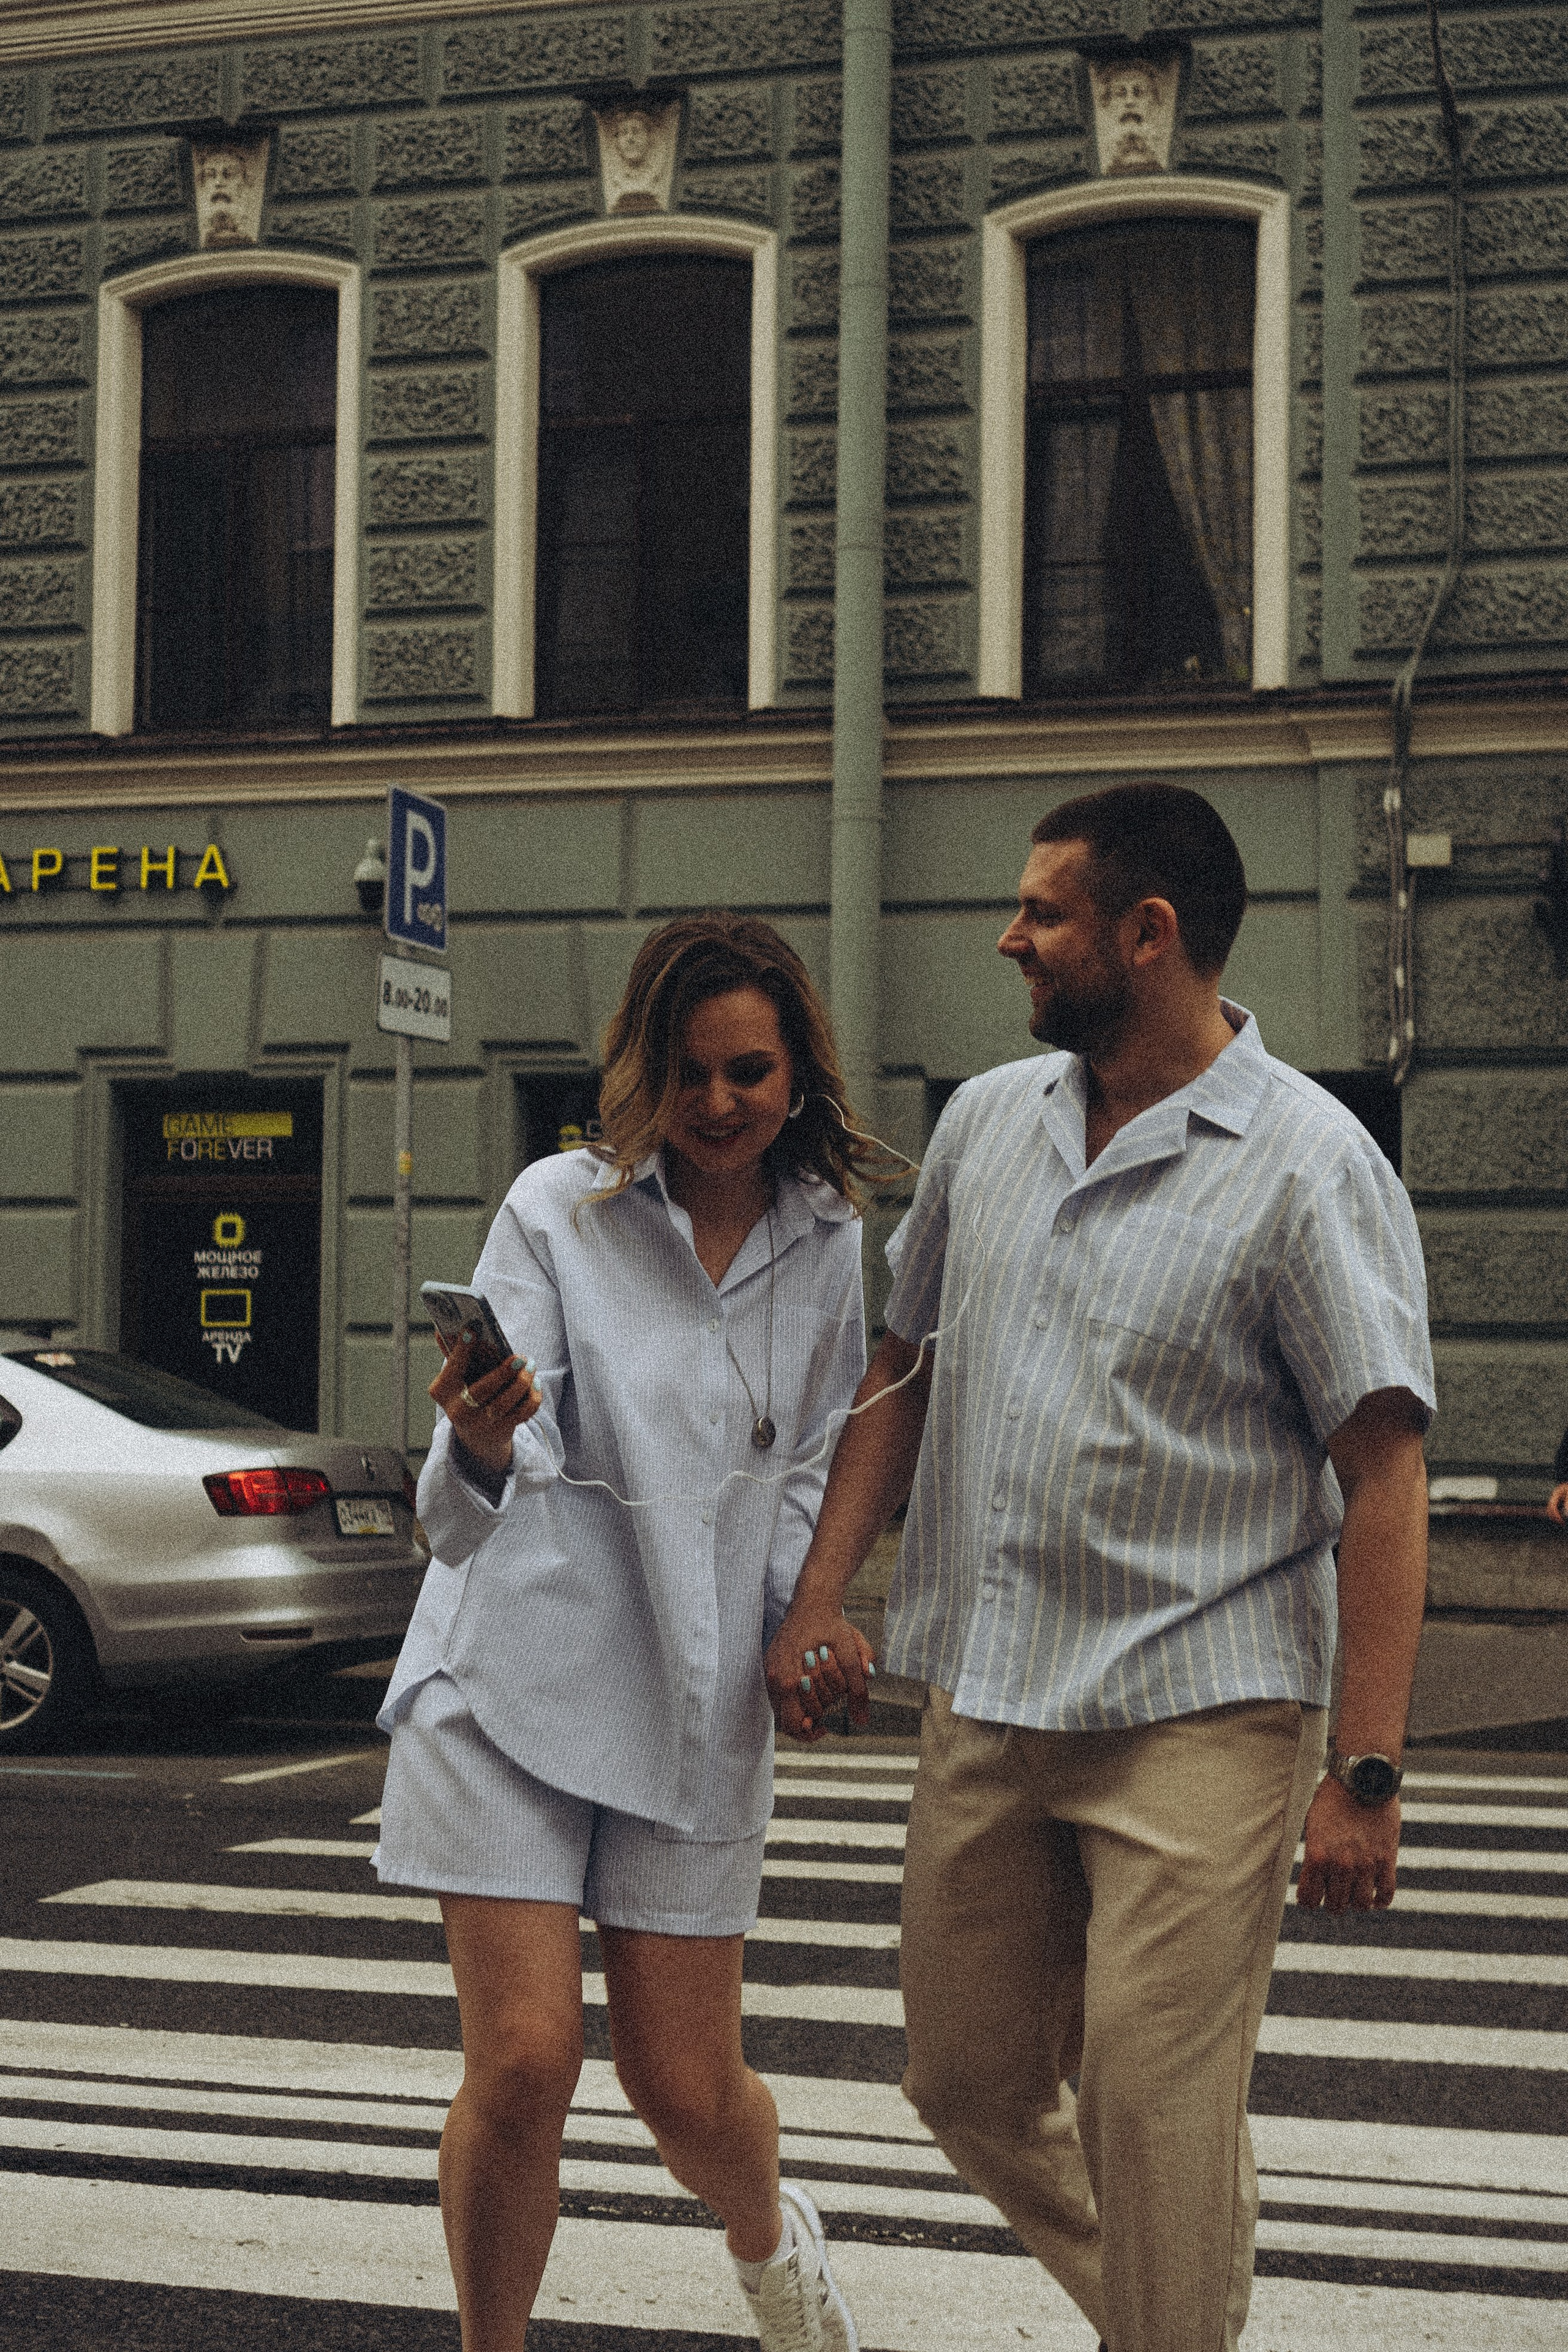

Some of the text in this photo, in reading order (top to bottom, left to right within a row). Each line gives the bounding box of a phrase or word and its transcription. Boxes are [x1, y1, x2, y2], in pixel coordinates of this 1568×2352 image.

[402, 809, 437, 925] P
[167, 1137, 273, 1161] FOREVER
[193, 1250, 263, 1265] МОЩНОЕ
[196, 1265, 260, 1280] ЖЕЛЕЗО
[212, 1344, 243, 1364] TV
